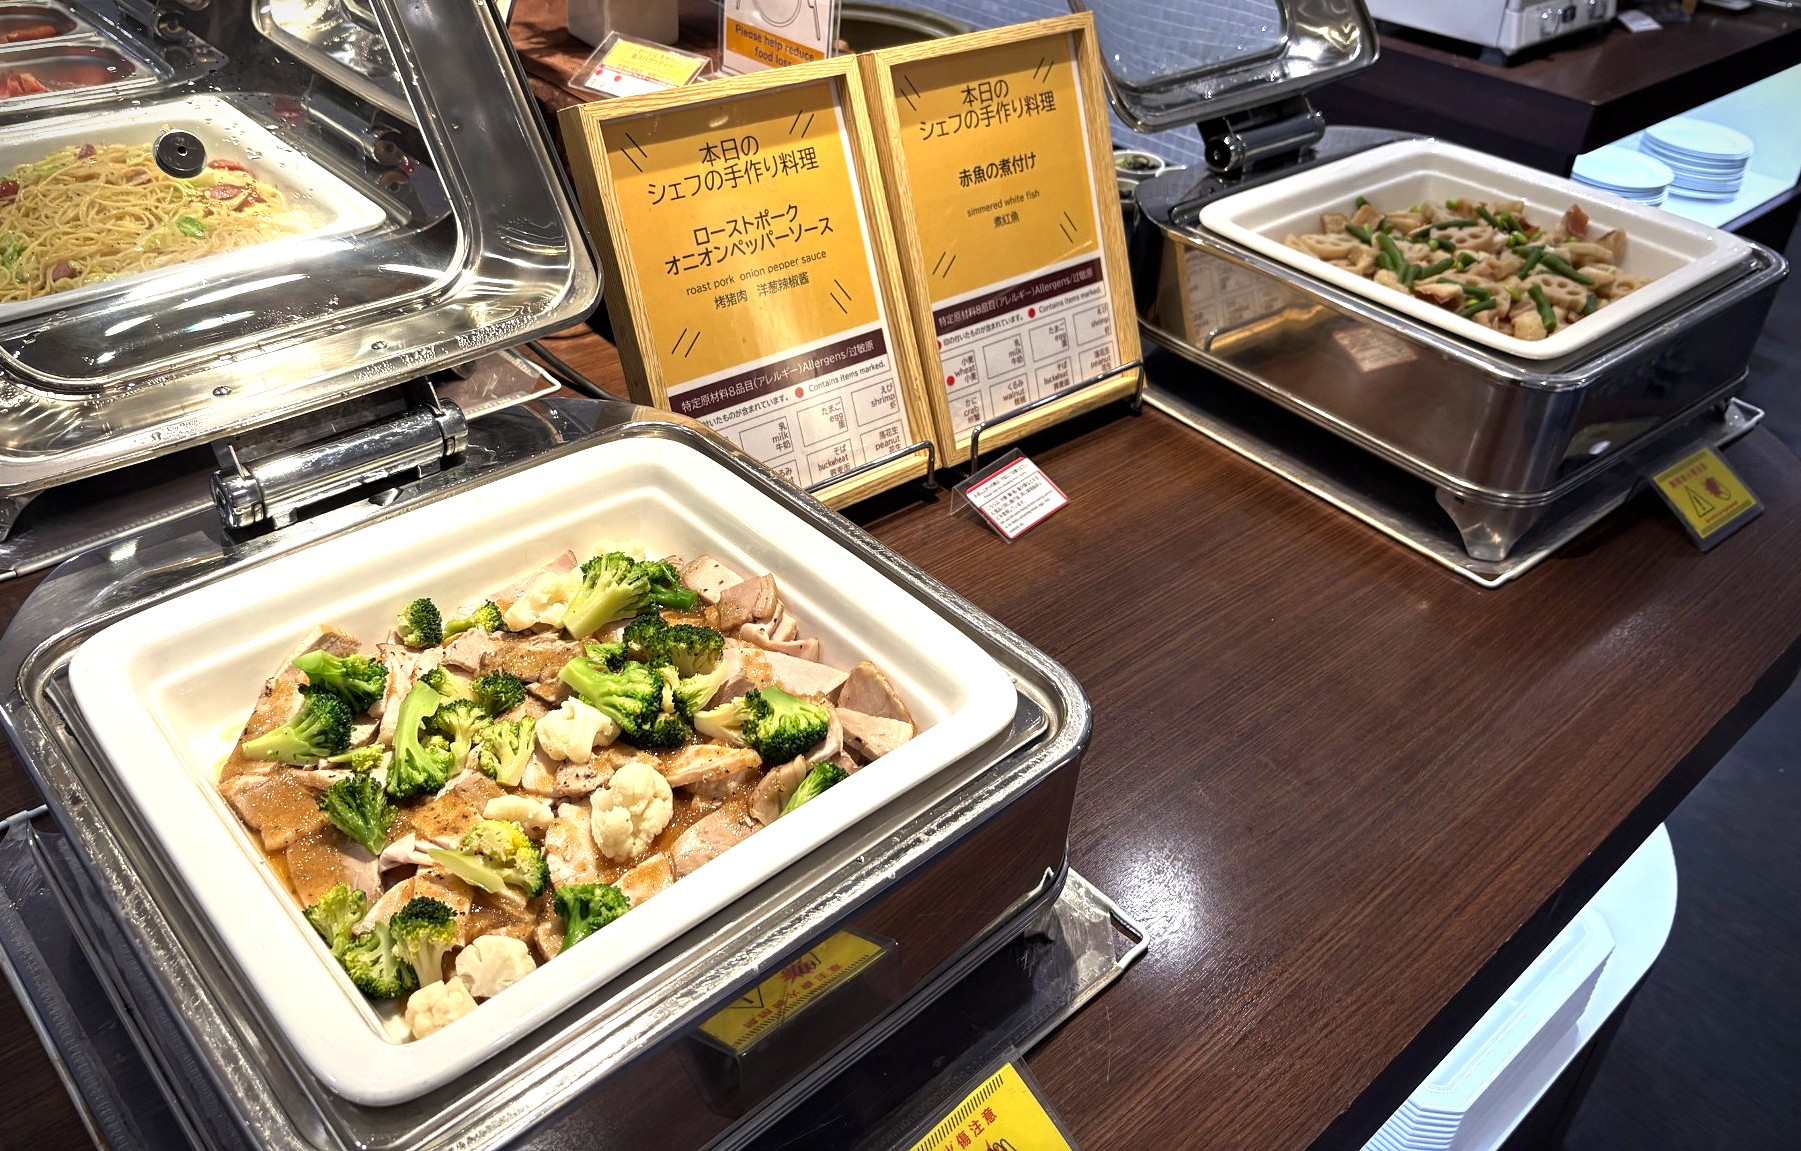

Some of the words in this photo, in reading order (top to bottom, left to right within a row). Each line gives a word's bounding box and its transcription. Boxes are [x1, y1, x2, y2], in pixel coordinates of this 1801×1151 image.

[735, 24, 762, 43] Please
[765, 34, 783, 51] help
[785, 45, 815, 61] reduce
[754, 46, 773, 61] food
[961, 79, 1009, 108] 本日の
[919, 91, 1056, 141] シェフの手作り料理
[699, 135, 759, 167] 本日の
[648, 147, 819, 205] シェフの手作り料理
[958, 151, 1036, 188] 赤魚の煮付け
[967, 199, 1003, 217] simmered
[1004, 194, 1024, 206] white
[1026, 189, 1040, 200] fish
[693, 204, 798, 246] ローストポーク
[664, 217, 833, 276] オニオンペッパーソース
[686, 282, 711, 296] roast
[714, 275, 735, 289] pork
[740, 267, 765, 281] onion
[767, 258, 799, 274] pepper
[801, 250, 827, 264] sauce
[1038, 300, 1063, 313] Contains
[809, 376, 839, 392] Contains
[840, 370, 858, 383] items
[859, 360, 886, 375] marked.
[954, 365, 976, 377] wheat
[881, 382, 893, 394] えび
[1003, 388, 1025, 401] walnut
[821, 401, 841, 415] たまご
[871, 393, 896, 407] shrimp
[829, 412, 844, 422] egg
[964, 406, 980, 417] crab
[772, 432, 790, 444] milk
[875, 435, 901, 451] peanut
[817, 453, 849, 471] buckwheat
